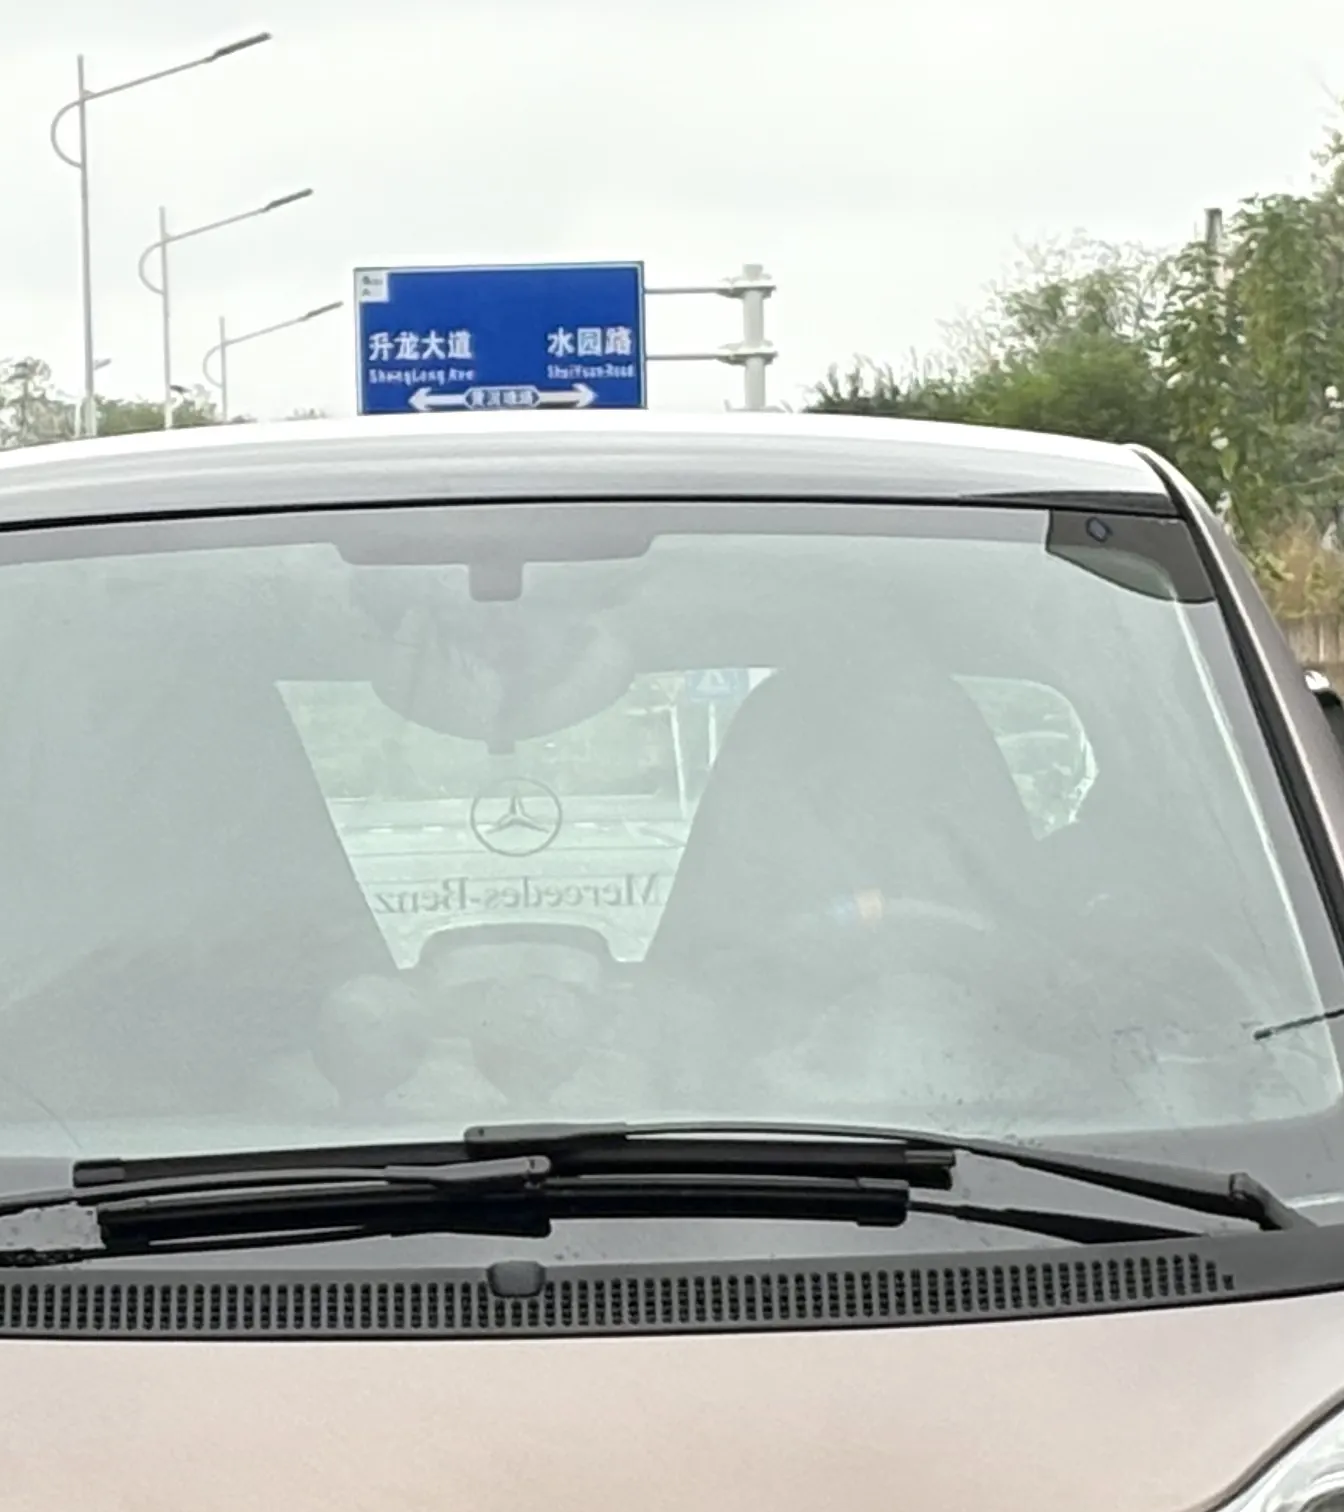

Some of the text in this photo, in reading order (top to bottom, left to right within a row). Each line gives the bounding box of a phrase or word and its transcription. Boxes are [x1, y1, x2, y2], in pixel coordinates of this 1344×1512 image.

[368, 329, 474, 361] 升龙大道
[547, 326, 632, 358] 水园路
